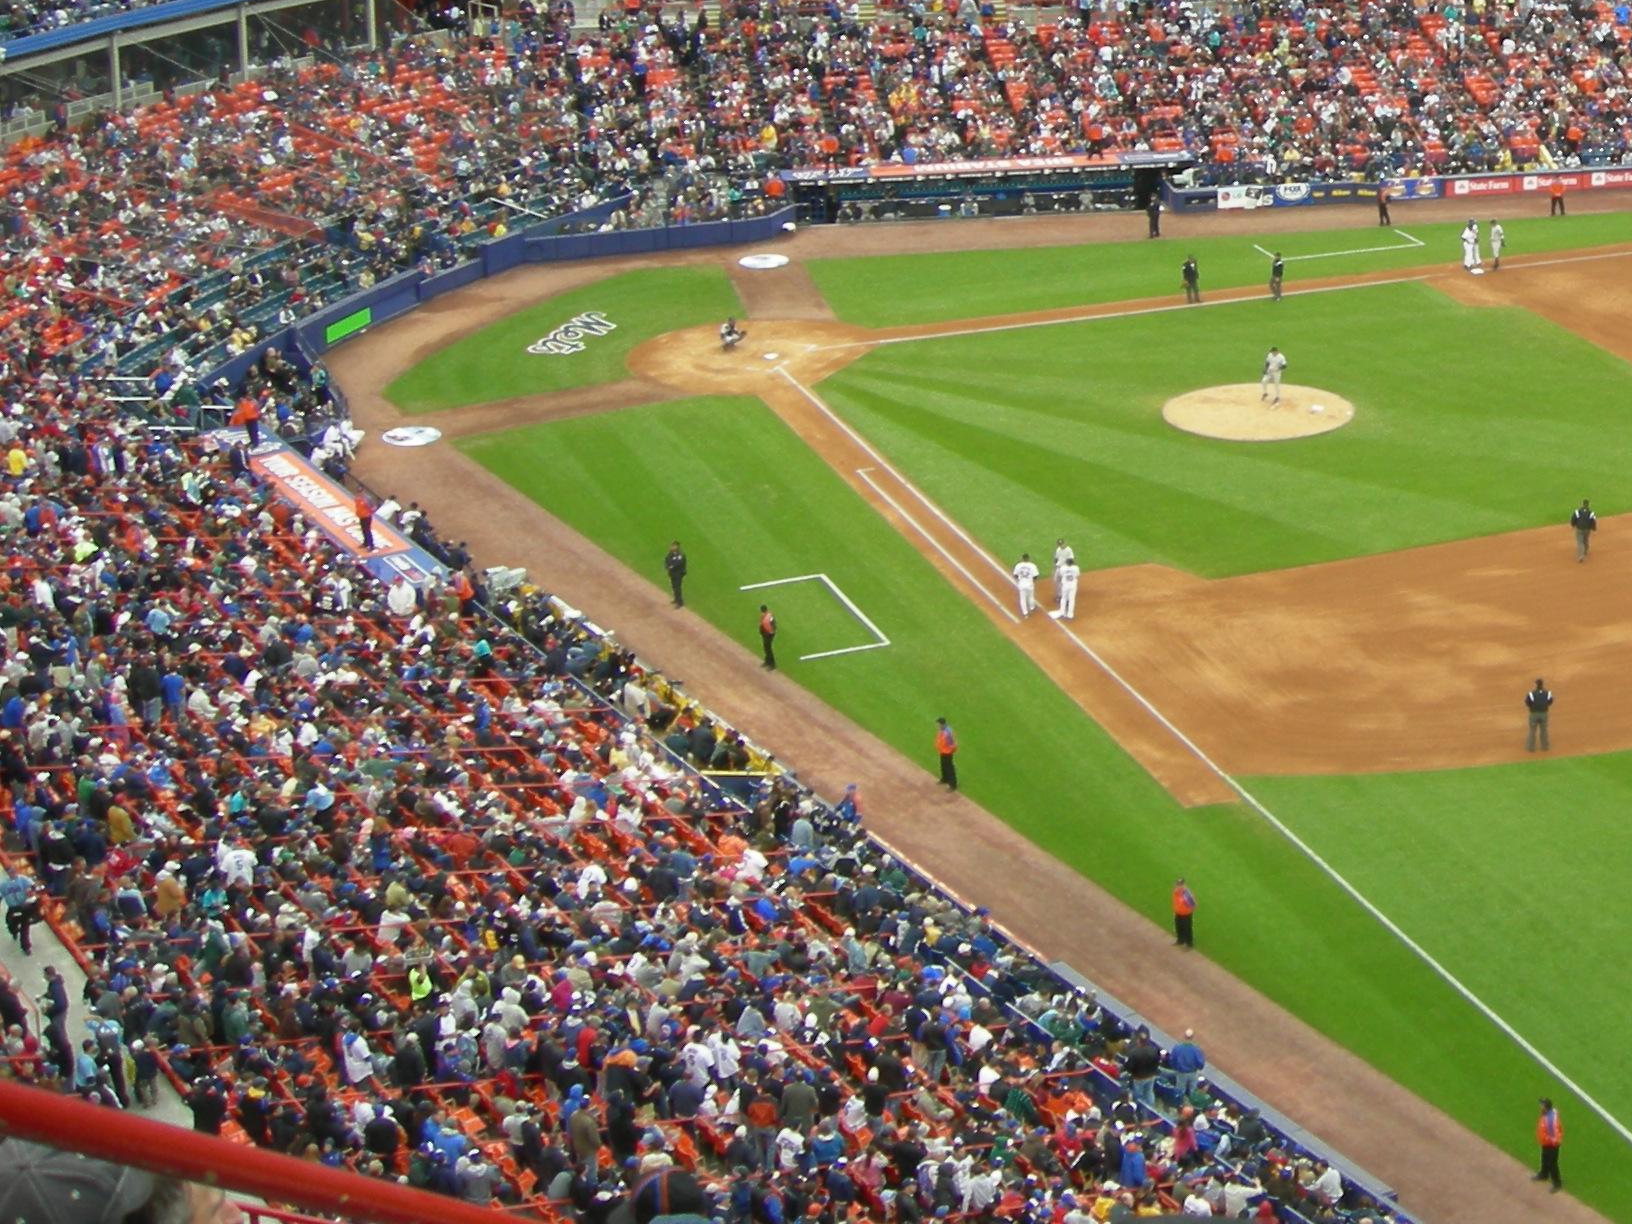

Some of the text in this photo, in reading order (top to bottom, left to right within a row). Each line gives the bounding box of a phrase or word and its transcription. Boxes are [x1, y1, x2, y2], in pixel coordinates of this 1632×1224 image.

[1606, 173, 1623, 182] State
[1470, 180, 1509, 190] State Farm
[526, 311, 617, 354] Mets
